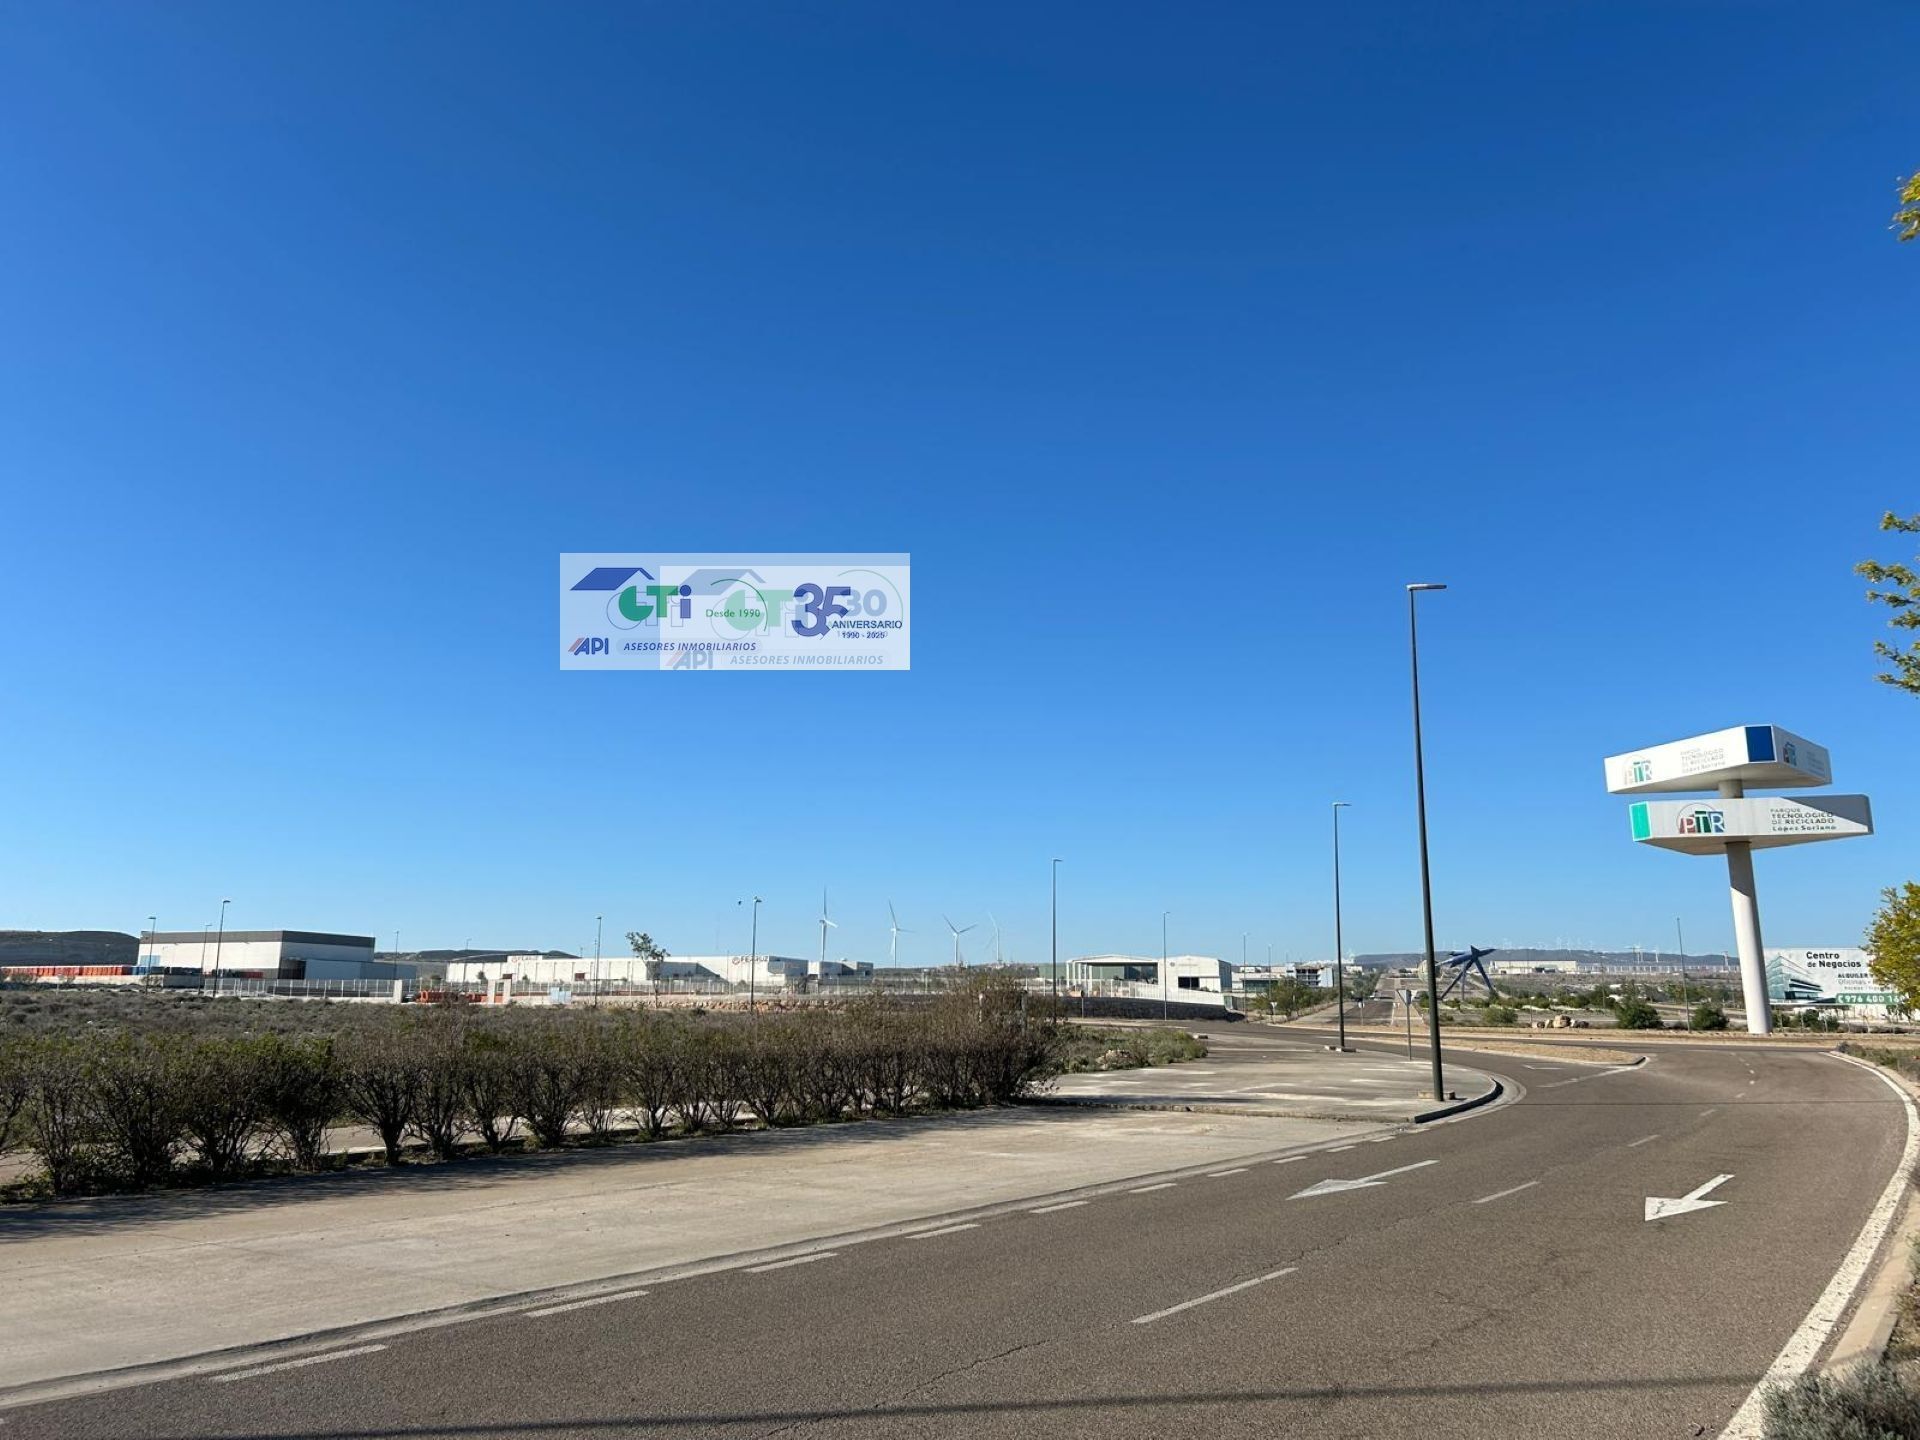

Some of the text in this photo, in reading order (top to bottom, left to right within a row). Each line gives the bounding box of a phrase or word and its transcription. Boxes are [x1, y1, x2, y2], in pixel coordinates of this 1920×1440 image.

[1679, 810, 1725, 834] PTR
[1806, 951, 1840, 959] Centro
[1818, 960, 1862, 968] Negocios
